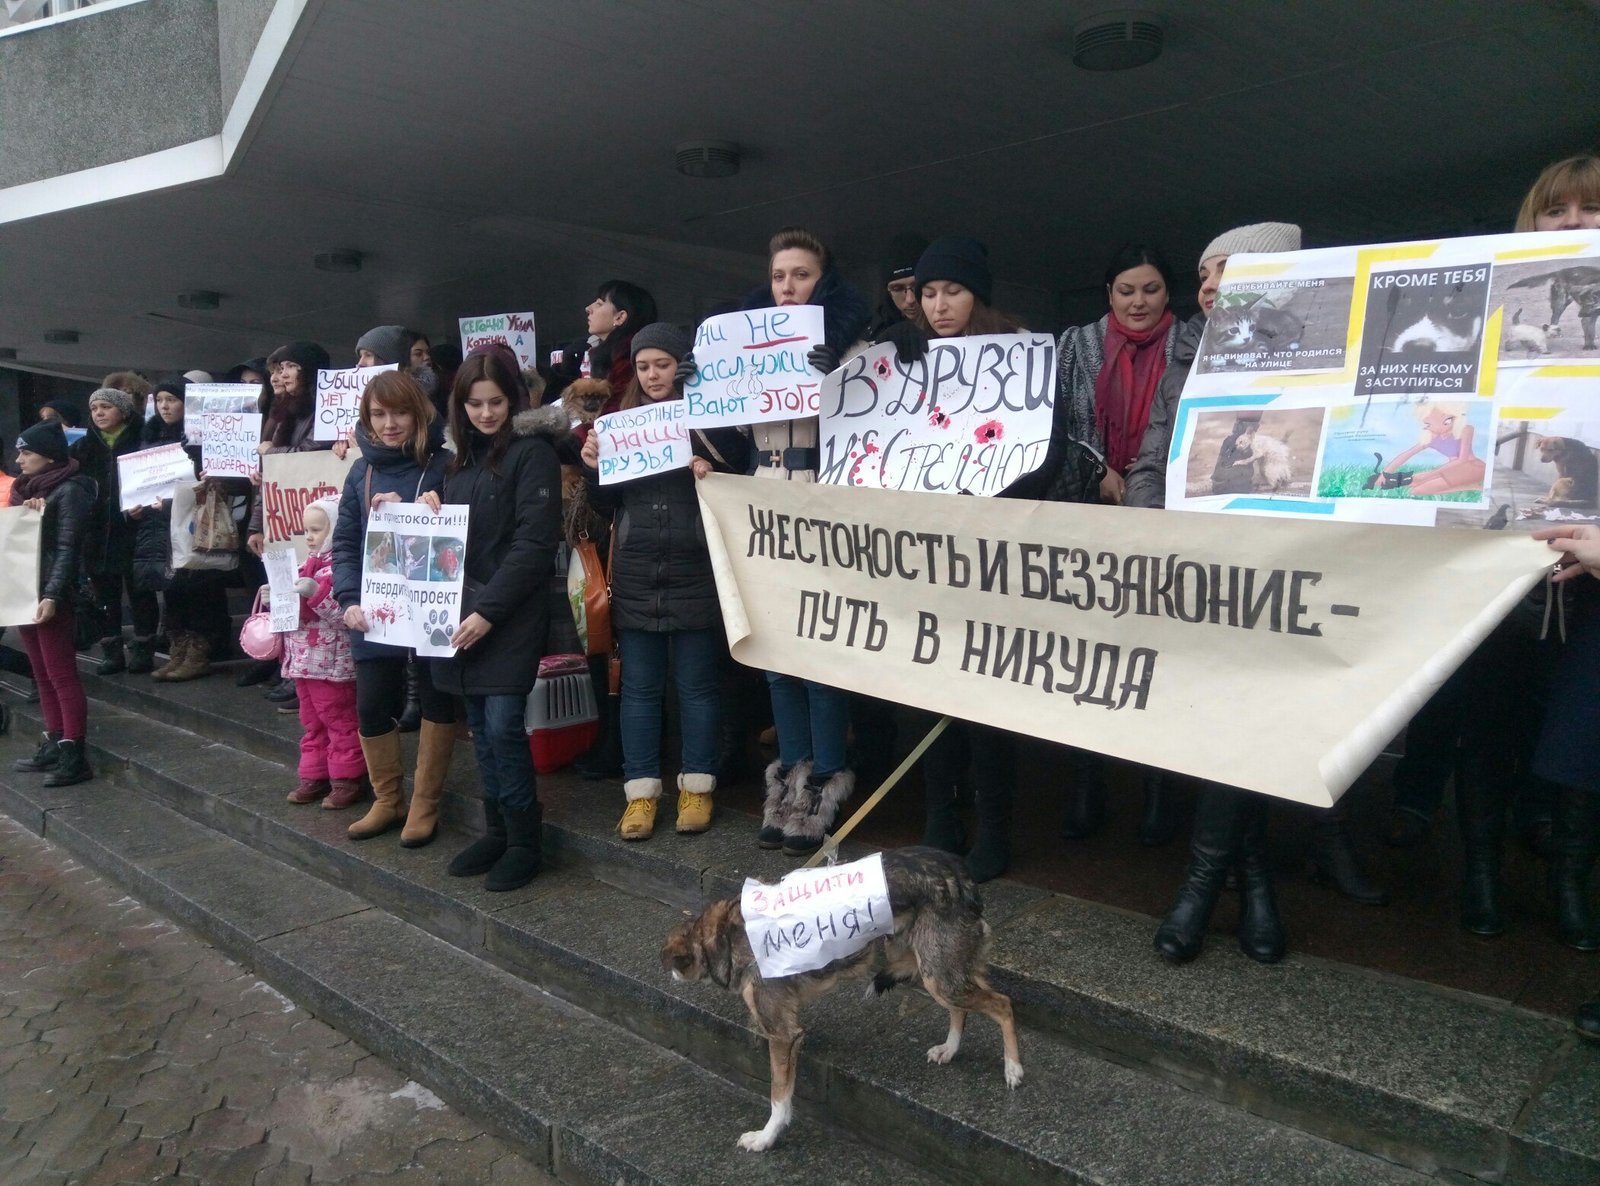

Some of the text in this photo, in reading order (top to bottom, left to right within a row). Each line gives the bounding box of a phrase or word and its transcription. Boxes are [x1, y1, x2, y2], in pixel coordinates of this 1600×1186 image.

[1297, 279, 1325, 288] МЕНЯ
[1373, 268, 1487, 289] КРОМЕ ТЕБЯ
[1274, 350, 1293, 358] ЧТО
[1295, 348, 1342, 358] РОДИЛСЯ
[1245, 360, 1292, 369] НА УЛИЦЕ
[1360, 363, 1473, 376] ЗА НИХ НЕКОМУ
[827, 338, 1053, 419] В ДРУЗЕЙ
[1364, 377, 1463, 389] ЗАСТУПИТЬСЯ
[747, 502, 972, 588] ЖЕСТОКОСТЬ
[979, 538, 1010, 595] И
[796, 590, 1160, 711] ПУТЬ В НИКУДА
